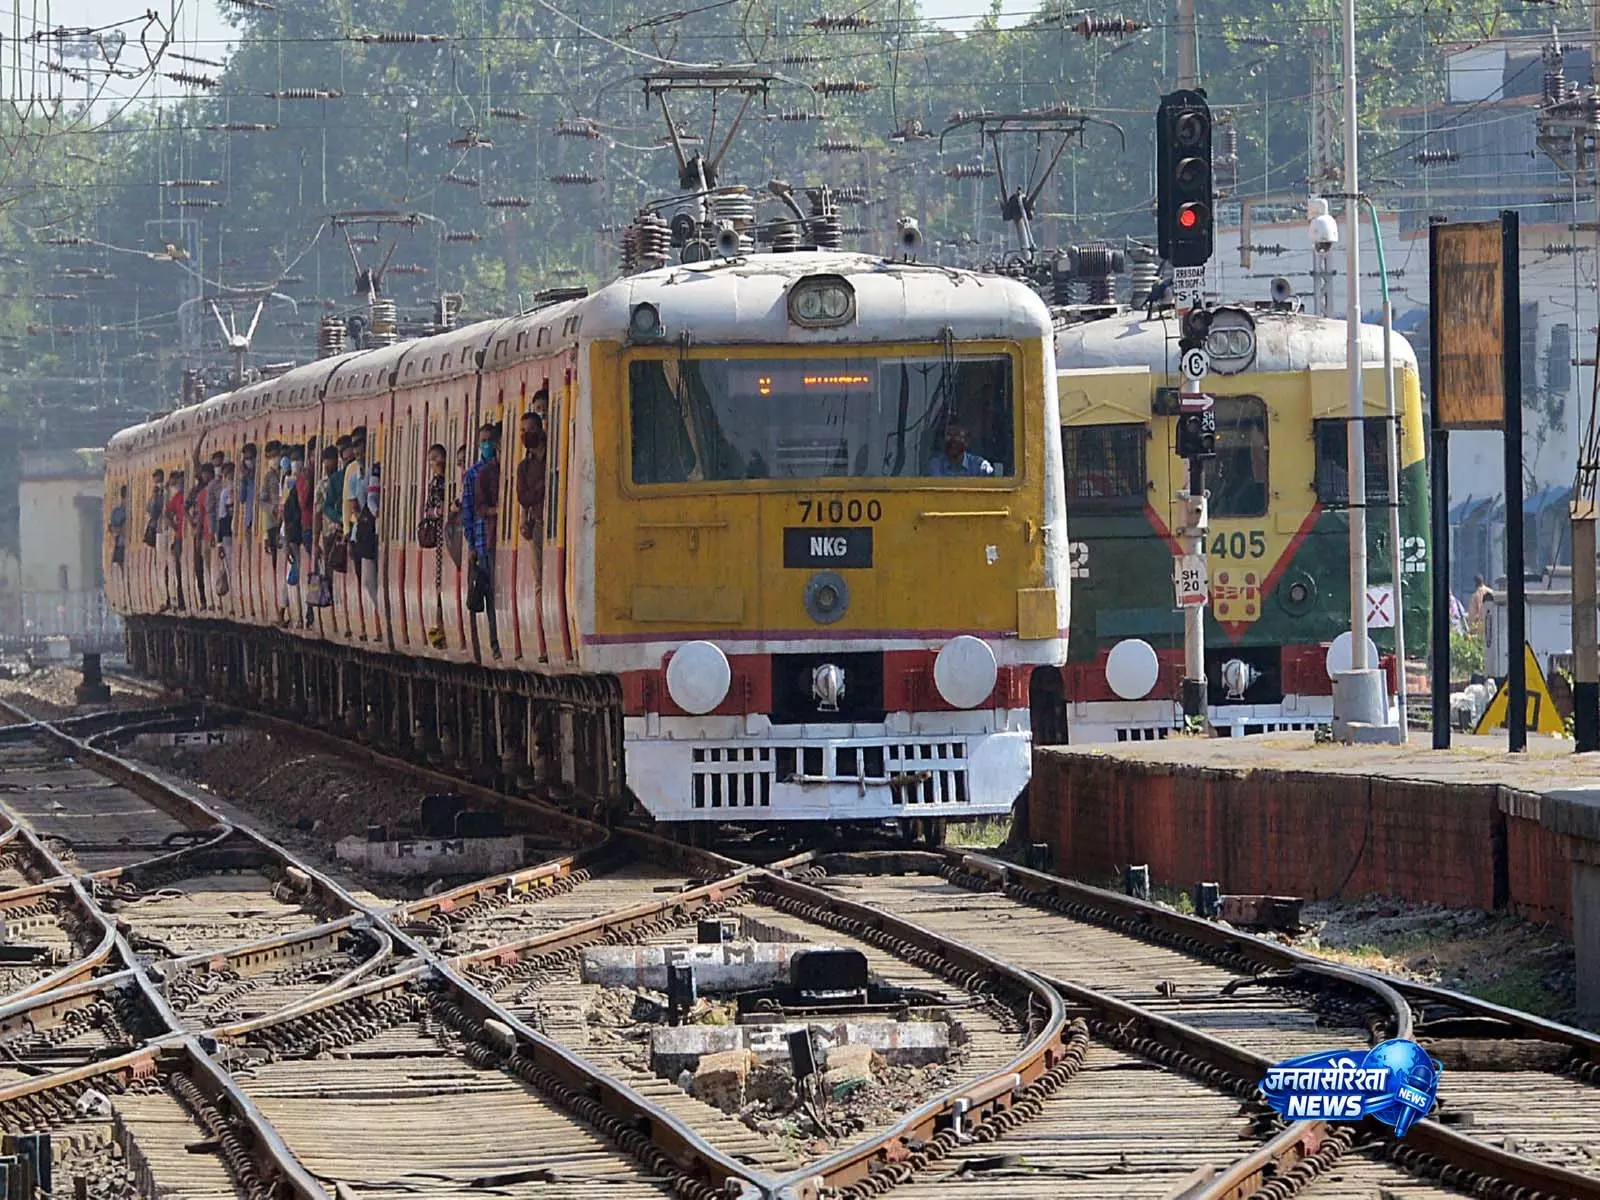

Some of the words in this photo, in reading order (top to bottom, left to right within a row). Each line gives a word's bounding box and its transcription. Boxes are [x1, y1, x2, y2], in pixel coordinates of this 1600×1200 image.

[1203, 412, 1214, 420] SH
[1202, 420, 1215, 431] 20
[797, 499, 882, 523] 71000
[810, 536, 848, 556] NKG
[1182, 570, 1199, 581] SH
[1183, 580, 1200, 592] 20
